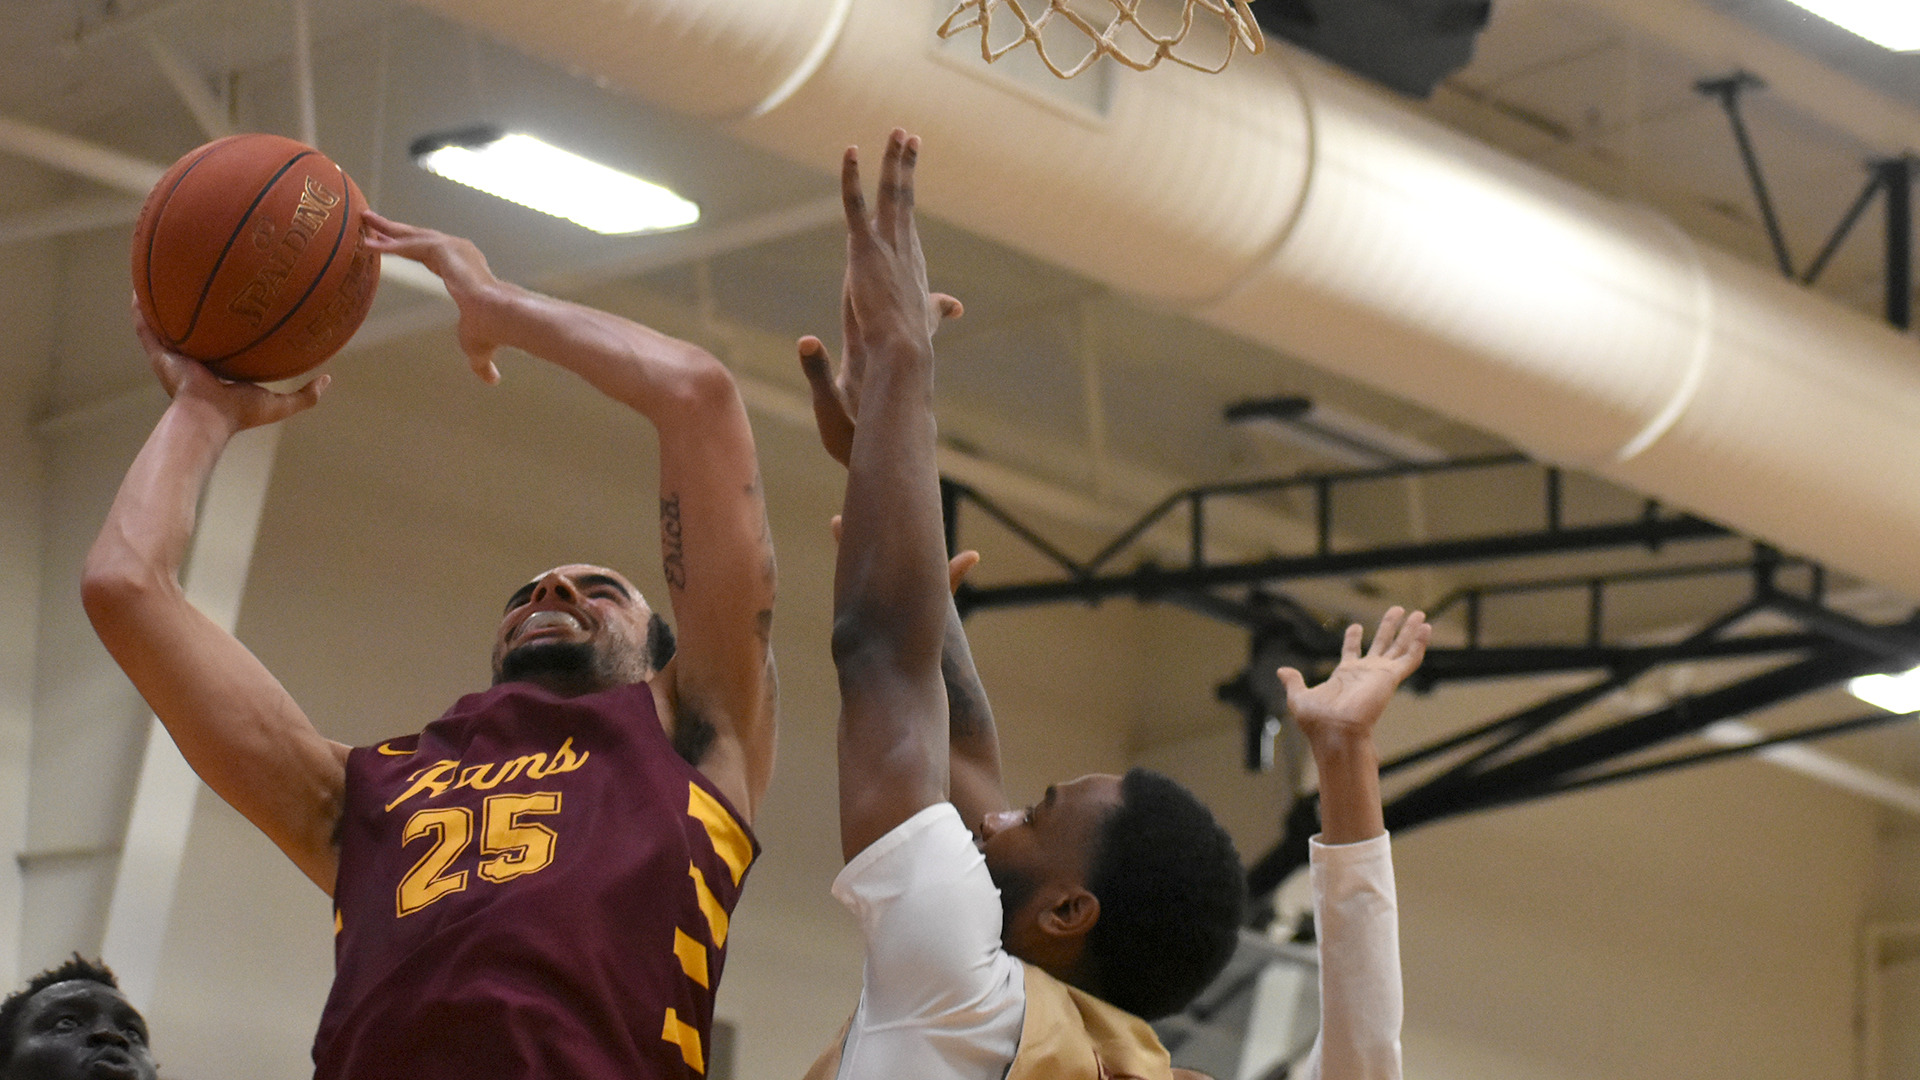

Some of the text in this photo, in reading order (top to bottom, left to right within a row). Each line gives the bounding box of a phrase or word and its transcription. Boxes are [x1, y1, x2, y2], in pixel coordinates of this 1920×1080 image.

[228, 175, 340, 327] SPALDING
[385, 737, 590, 812] Rams
[396, 791, 563, 918] 25
